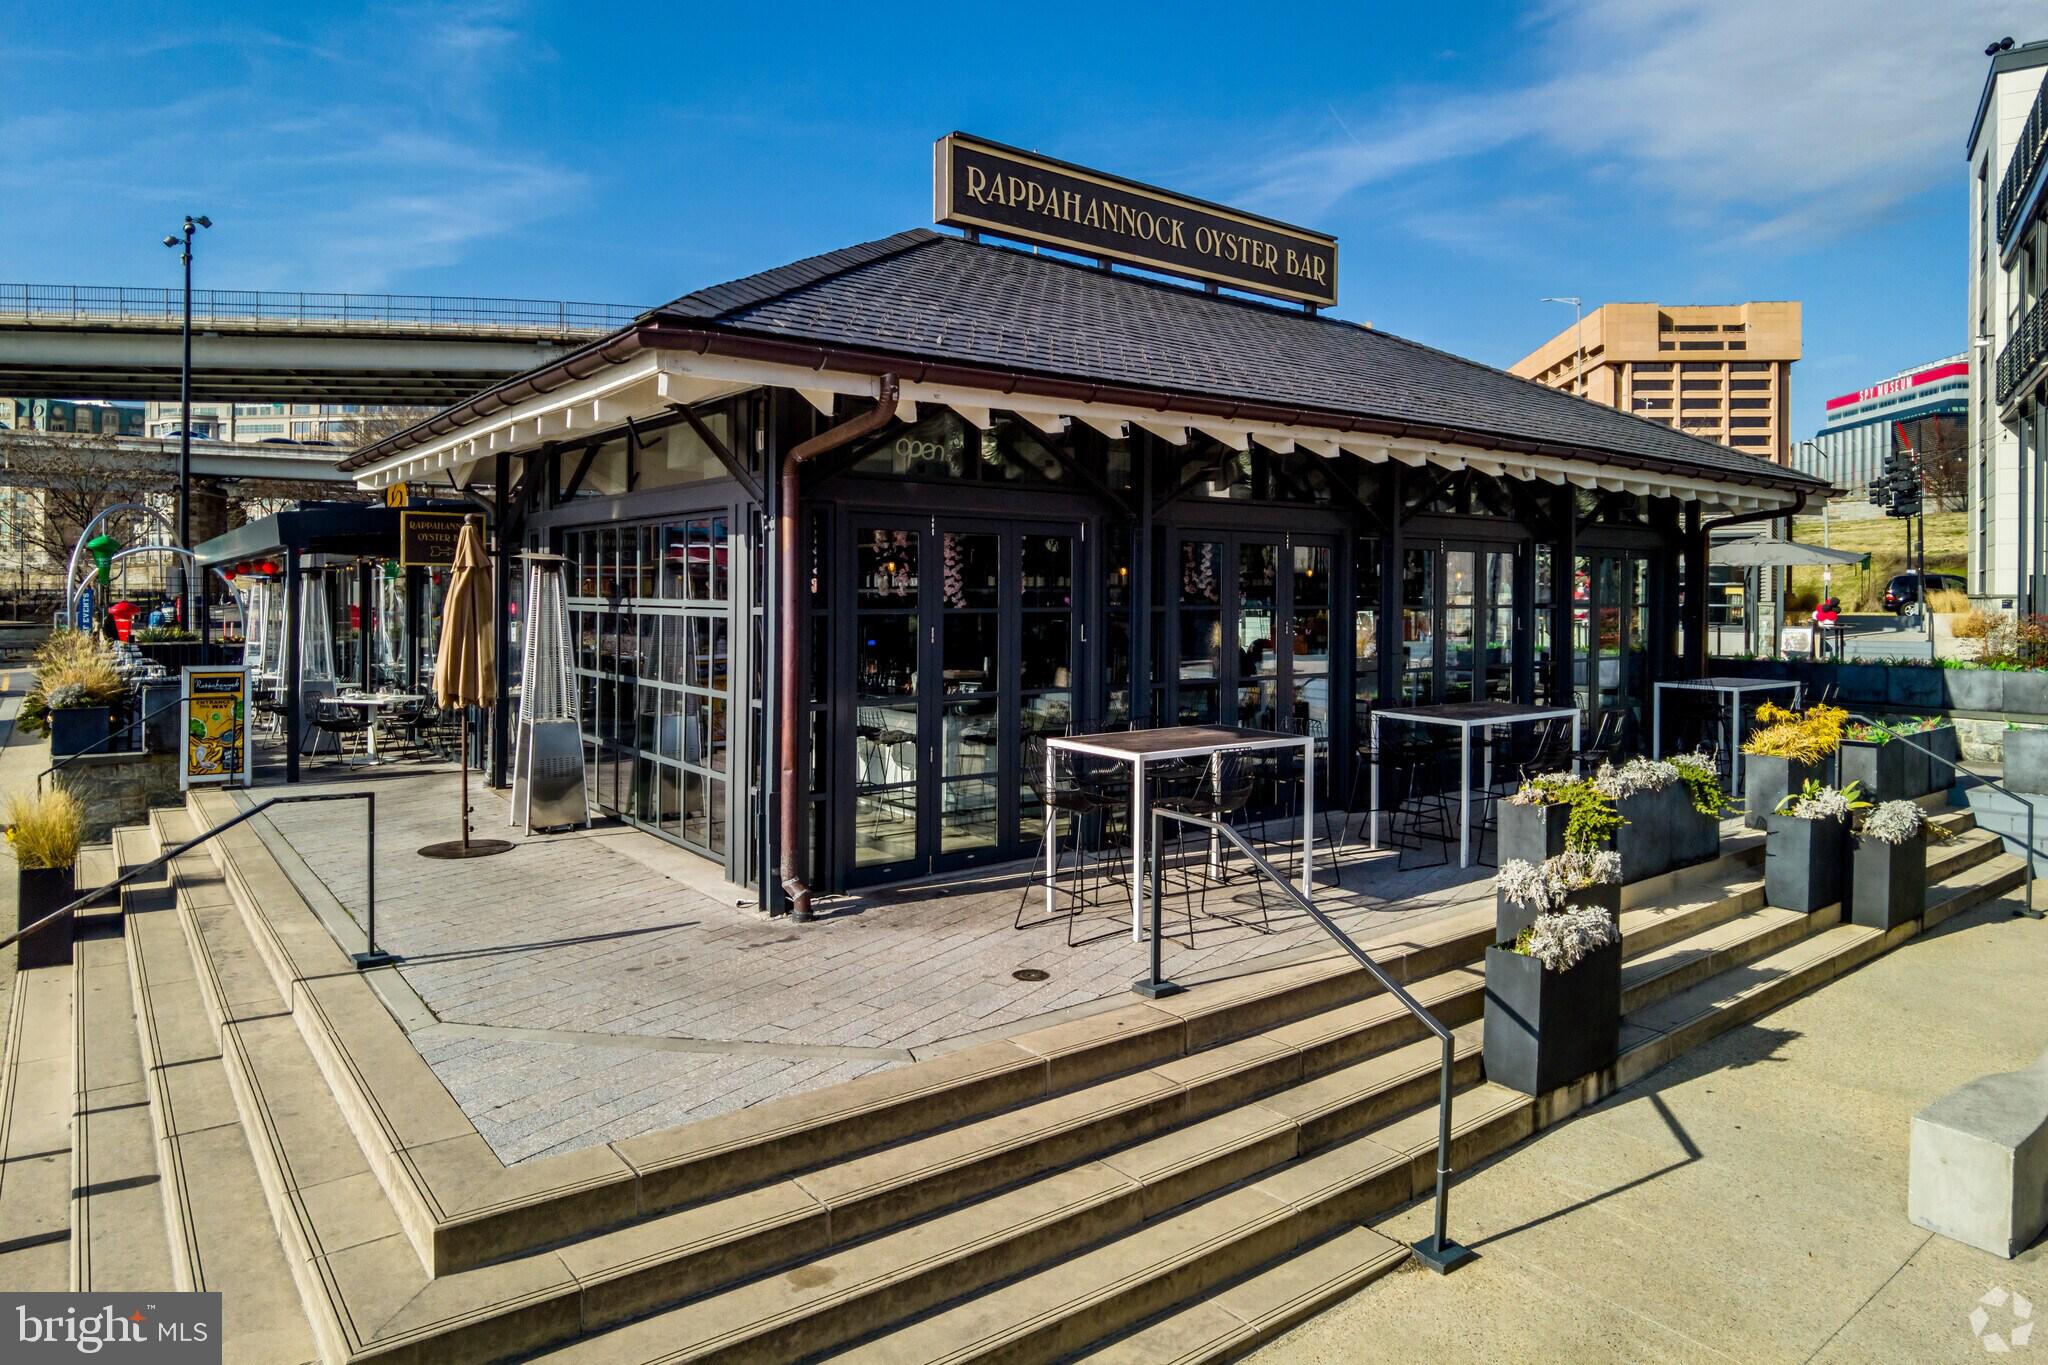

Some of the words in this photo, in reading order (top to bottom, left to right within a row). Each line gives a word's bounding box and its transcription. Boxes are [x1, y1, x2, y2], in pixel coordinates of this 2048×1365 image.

[966, 165, 1187, 249] RAPPAHANNOCK
[1195, 226, 1278, 275] OYSTER
[1286, 248, 1327, 286] BAR
[1859, 388, 1874, 401] SPY
[1877, 376, 1913, 395] MUSEUM
[896, 438, 945, 468] open
[417, 533, 451, 543] OYSTER
[82, 592, 90, 623] EVENTS
